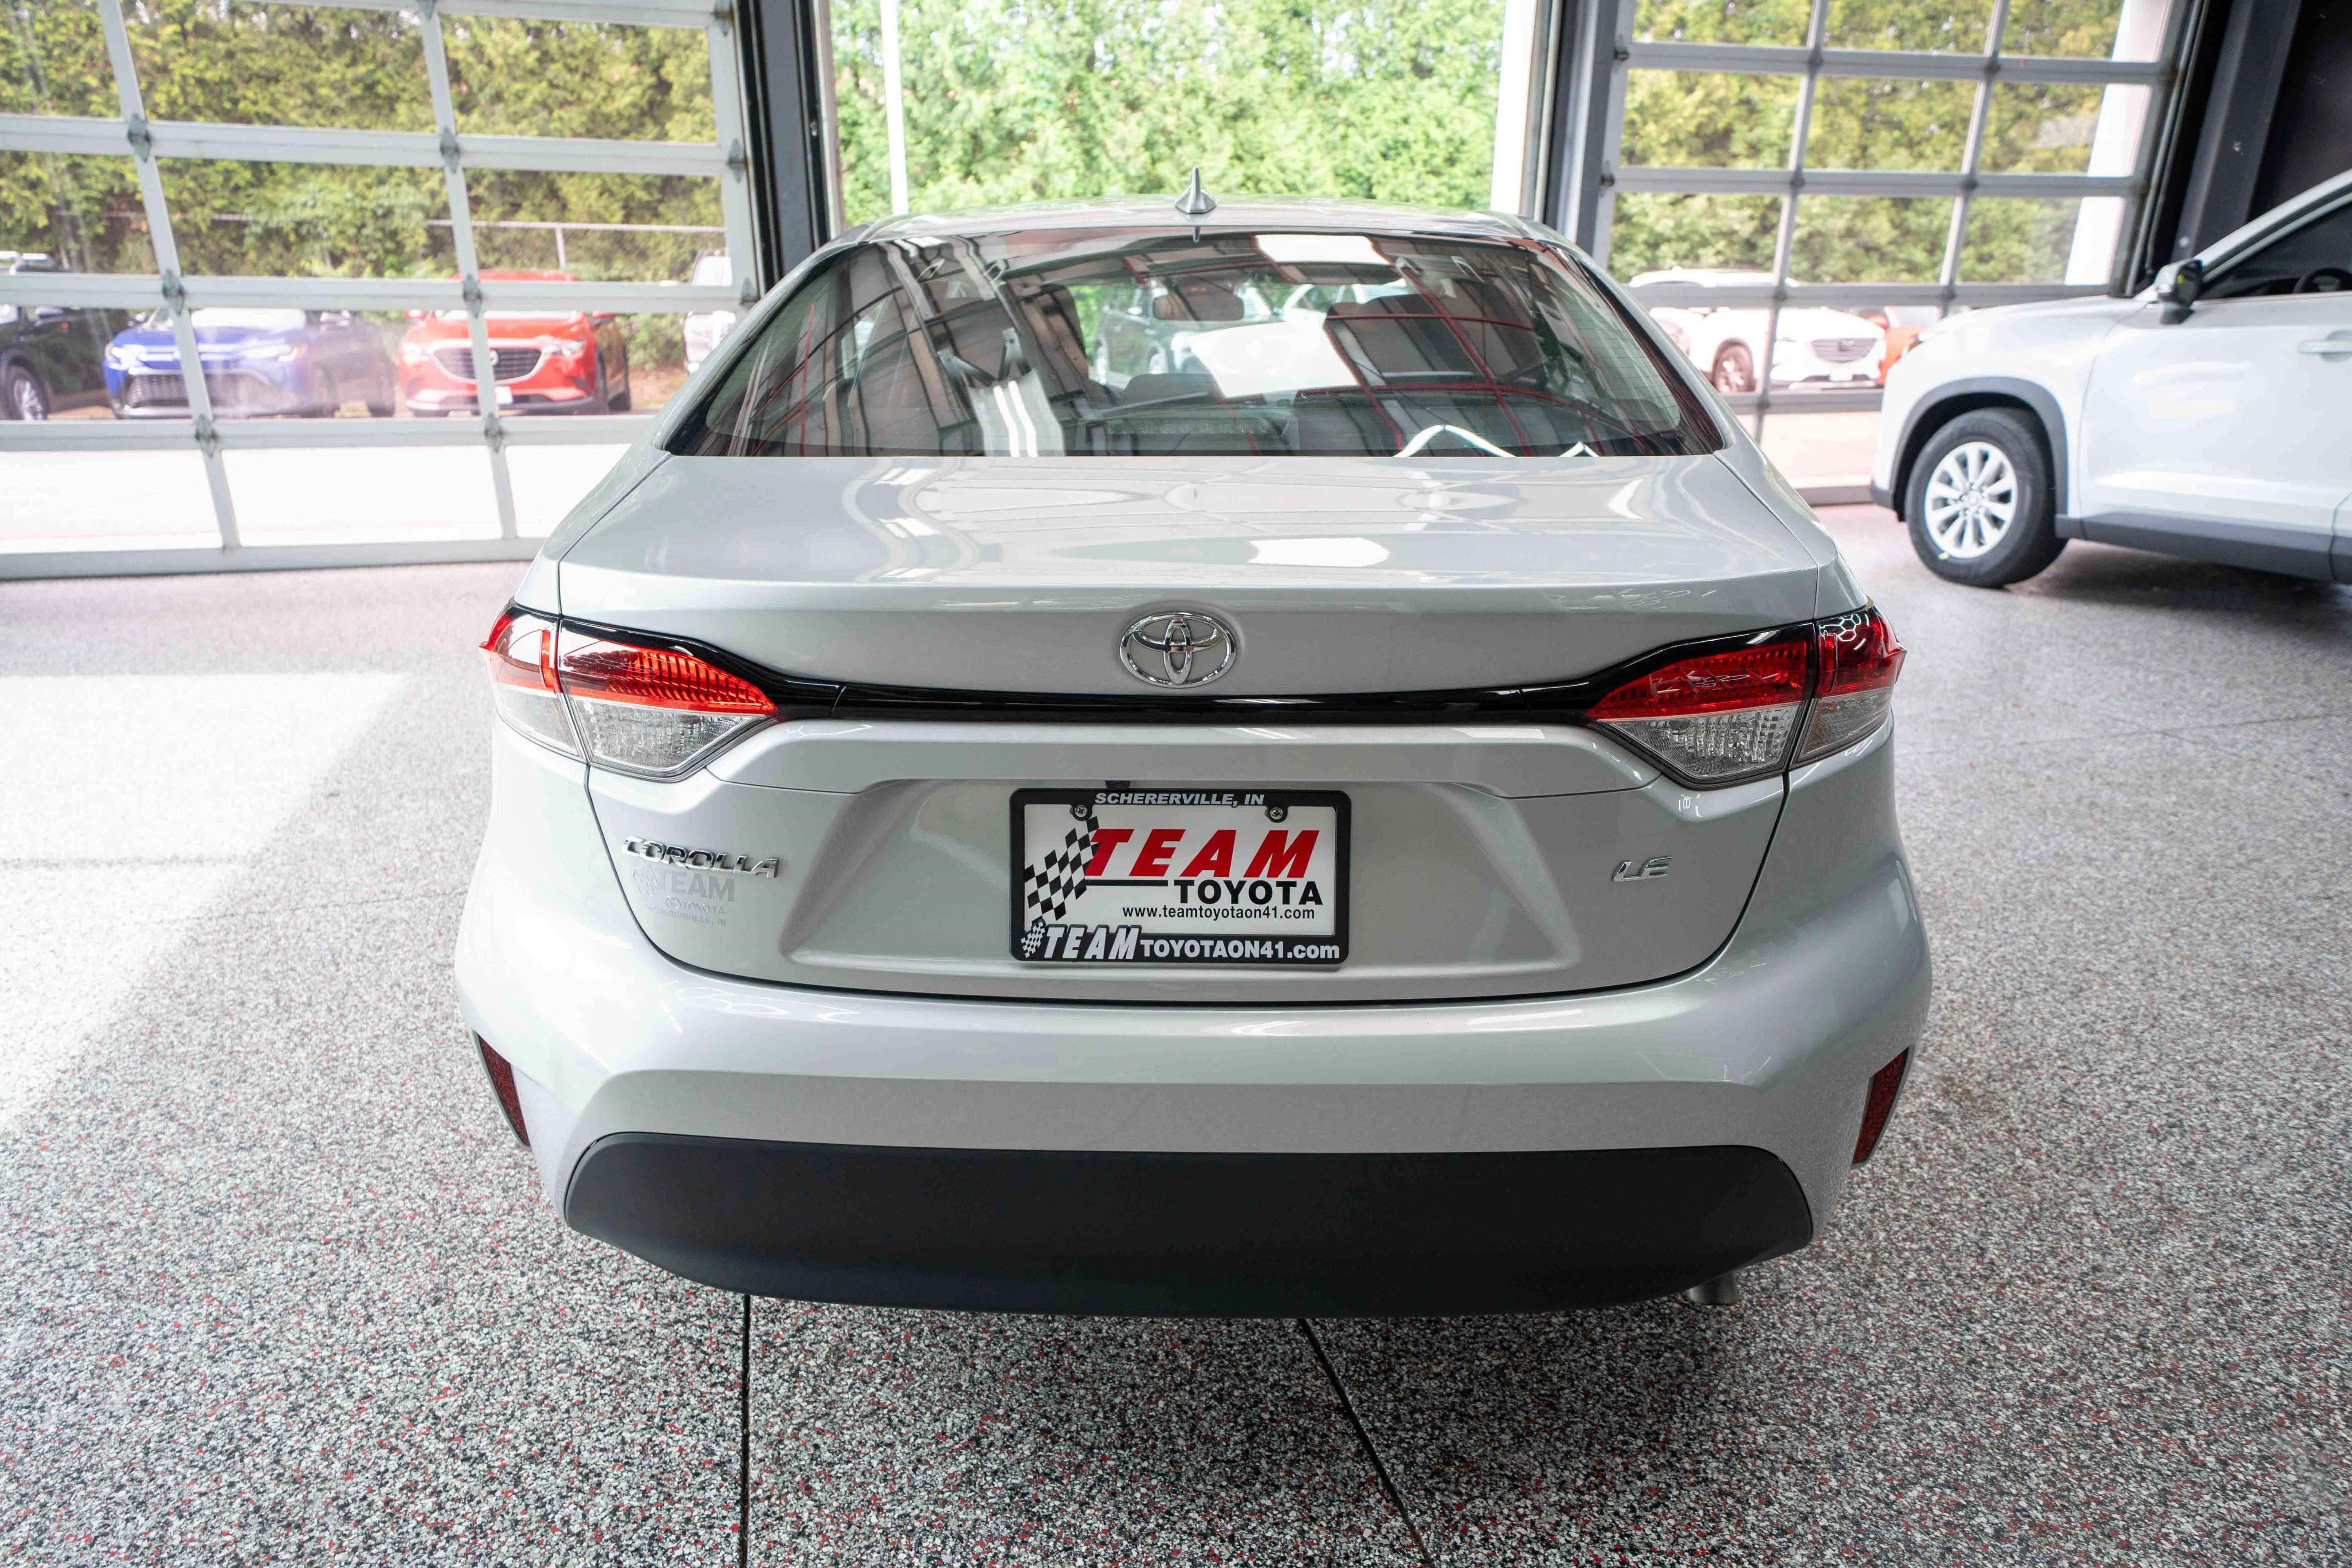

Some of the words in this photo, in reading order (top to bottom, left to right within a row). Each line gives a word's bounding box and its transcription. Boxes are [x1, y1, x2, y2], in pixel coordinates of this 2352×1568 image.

[1095, 793, 1238, 806] SCHERERVILLE,
[1244, 794, 1264, 805] IN
[622, 836, 780, 878] COROLLA
[1085, 829, 1320, 878] TEAM
[1612, 856, 1673, 882] LE
[656, 867, 735, 902] TEAM
[1174, 880, 1323, 905] TOYOTA
[683, 901, 725, 915] TOYOTA
[1122, 905, 1315, 920] www.teamtoyotaon41.com
[717, 918, 727, 926] IN
[1044, 927, 1139, 960] TEAM
[1140, 940, 1340, 959] TOYOTAON41.com
